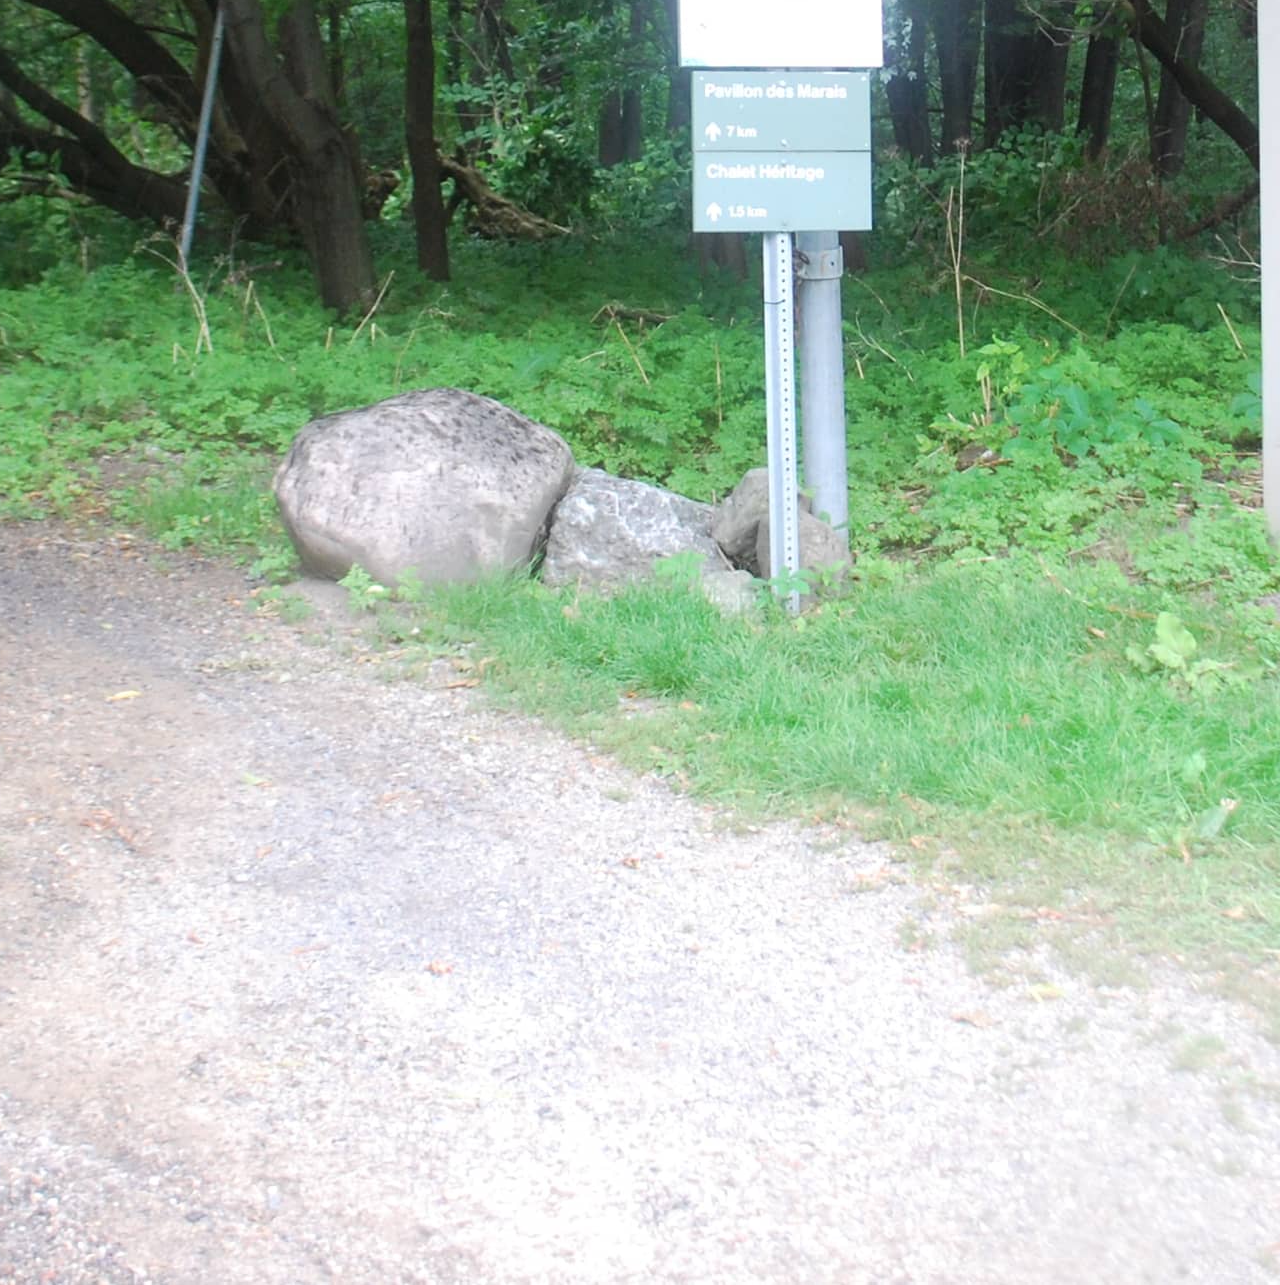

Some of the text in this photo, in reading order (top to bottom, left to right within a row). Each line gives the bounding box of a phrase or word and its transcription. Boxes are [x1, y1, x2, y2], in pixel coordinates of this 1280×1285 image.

[704, 83, 847, 99] Pavillon des Marais
[726, 125, 757, 138] 7 km
[706, 163, 825, 182] Chalet Héritage
[746, 205, 767, 218] km
